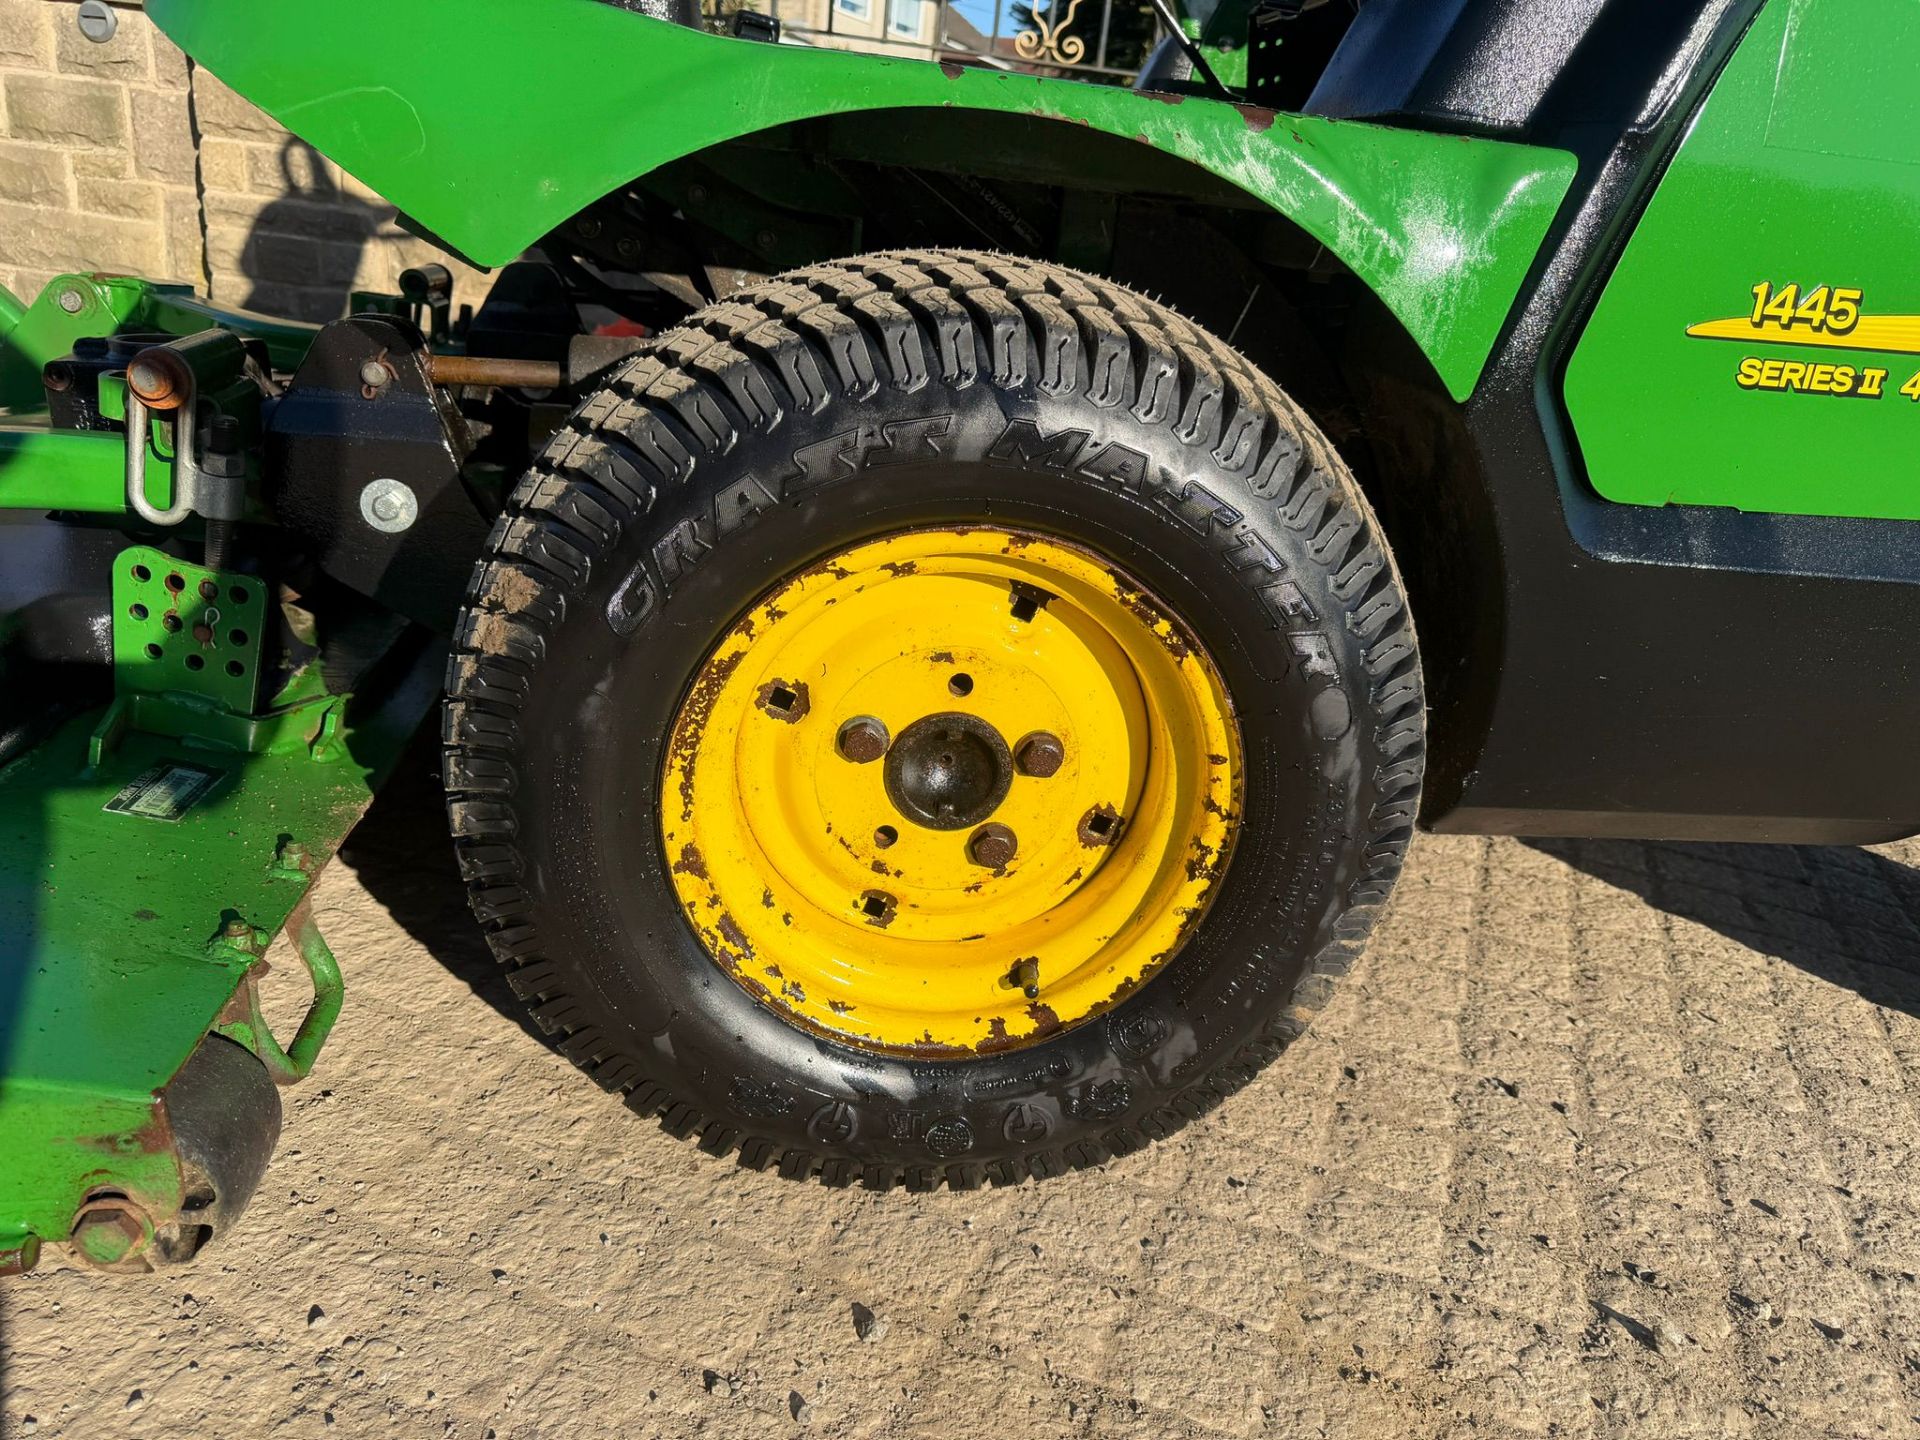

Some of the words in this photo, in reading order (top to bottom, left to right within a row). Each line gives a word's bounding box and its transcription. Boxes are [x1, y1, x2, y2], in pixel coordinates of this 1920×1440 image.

[1751, 281, 1862, 336] 1445
[1736, 358, 1855, 396] SERIES
[1857, 367, 1887, 400] II
[606, 414, 954, 638] GRASS
[986, 418, 1340, 682] MASTER
